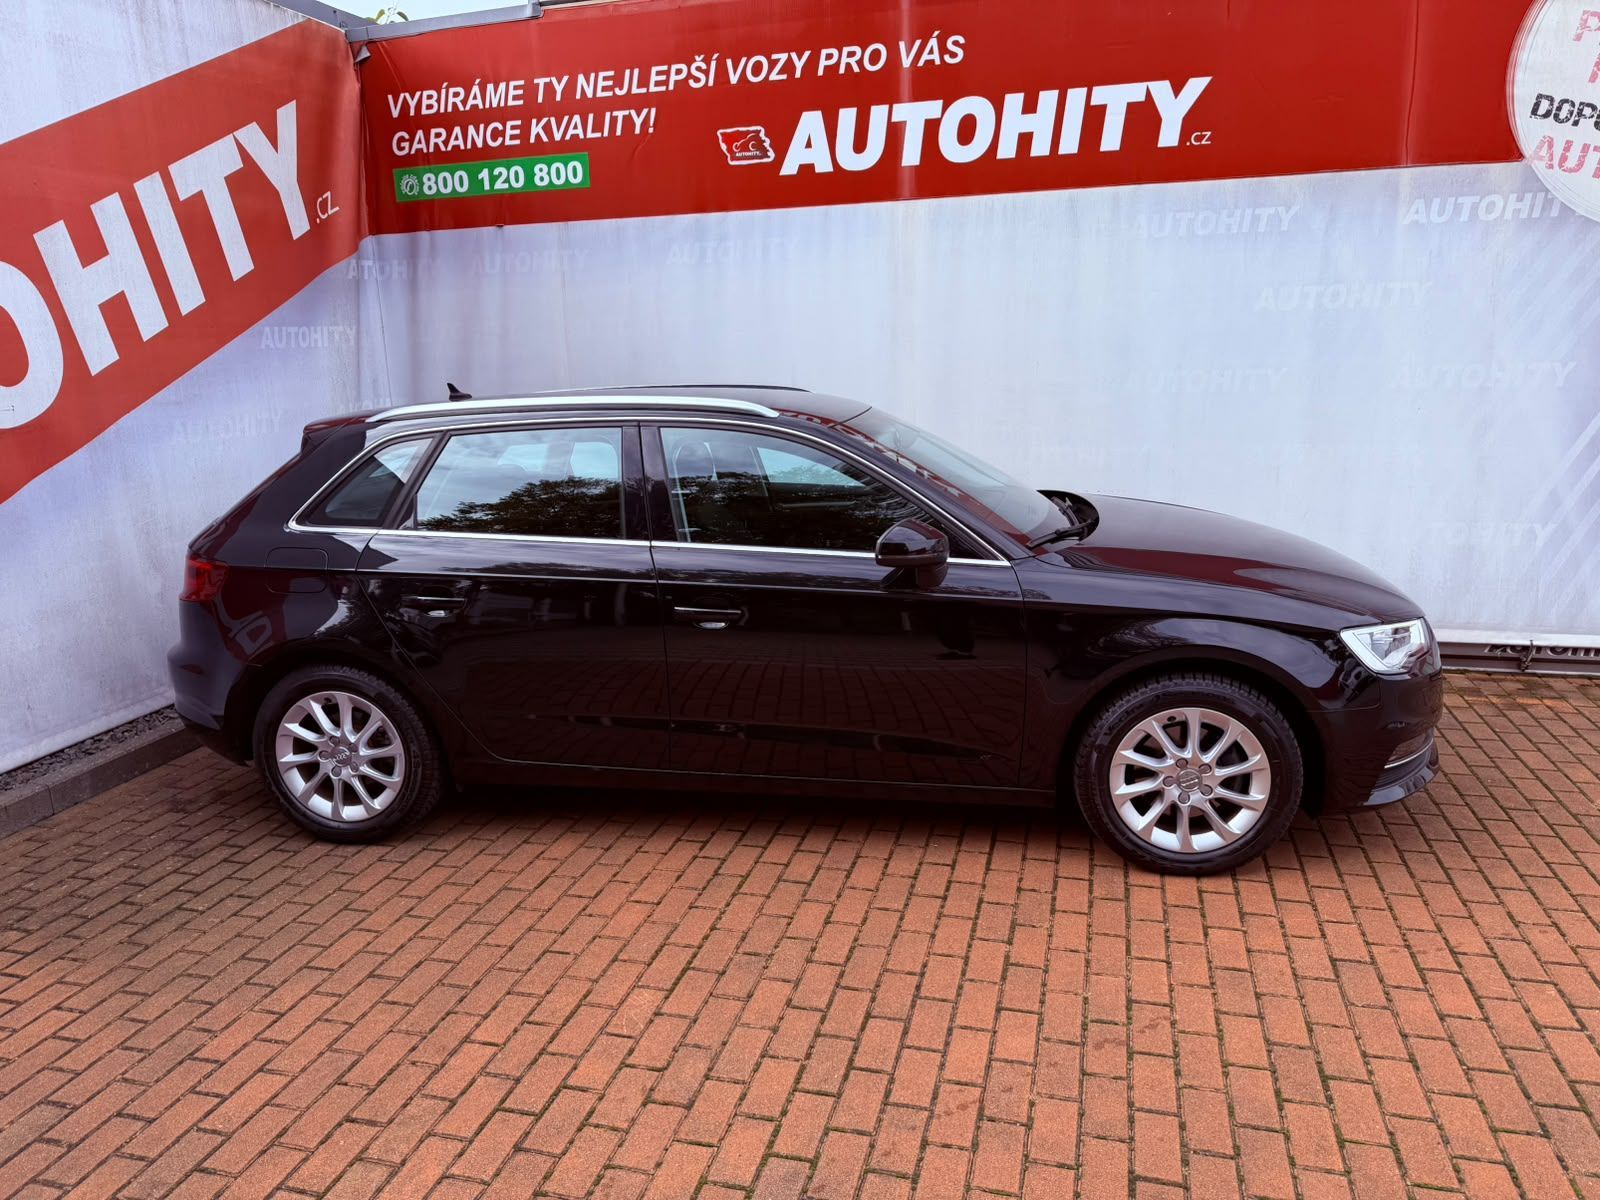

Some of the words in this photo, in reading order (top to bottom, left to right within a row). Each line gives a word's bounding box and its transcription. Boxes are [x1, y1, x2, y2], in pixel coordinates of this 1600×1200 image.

[387, 79, 524, 118] VYBÍRÁME
[533, 75, 569, 103] TY
[575, 53, 720, 99] NEJLEPŠÍ
[726, 50, 811, 84] VOZY
[817, 43, 888, 76] PRO
[899, 31, 966, 68] VÁS
[391, 120, 522, 156] GARANCE
[530, 107, 657, 144] KVALITY!
[422, 170, 469, 196] 800
[478, 165, 525, 191] 120
[533, 160, 584, 187] 800
[1132, 205, 1299, 238] AUTOHITY
[1253, 281, 1433, 313] AUTOHITY
[259, 325, 356, 349] AUTOHITY
